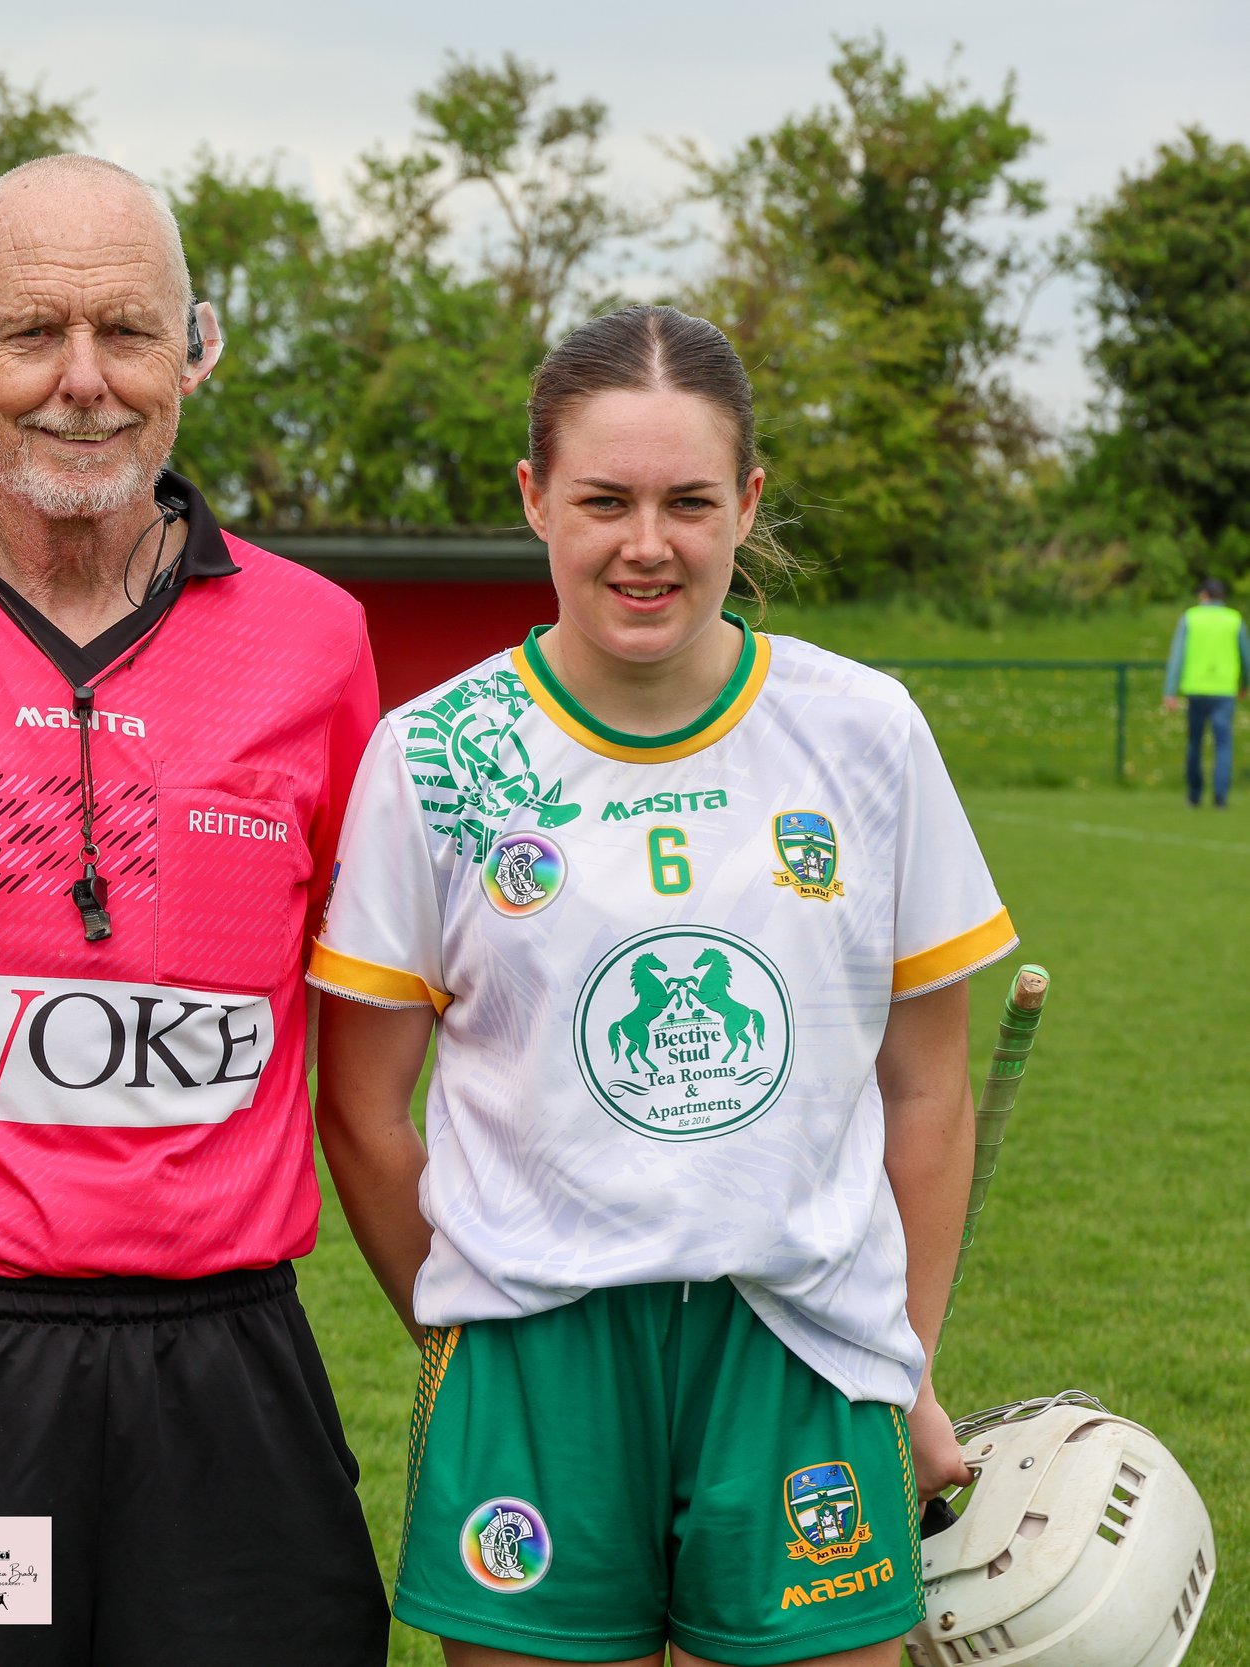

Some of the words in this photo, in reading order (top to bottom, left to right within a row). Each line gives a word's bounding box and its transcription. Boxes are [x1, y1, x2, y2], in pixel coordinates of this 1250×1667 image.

[189, 806, 288, 843] RÉITEOIR
[645, 825, 694, 897] 6
[780, 875, 790, 883] 18
[654, 1026, 721, 1049] Bective
[668, 1043, 710, 1065] Stud
[645, 1072, 675, 1087] Tea
[679, 1066, 736, 1083] Rooms
[684, 1084, 699, 1098] &
[646, 1097, 742, 1121] Apartments
[678, 1119, 690, 1127] Est
[691, 1116, 711, 1125] 2016
[858, 1529, 866, 1538] 87
[794, 1545, 805, 1554] 18
[816, 1551, 829, 1561] An
